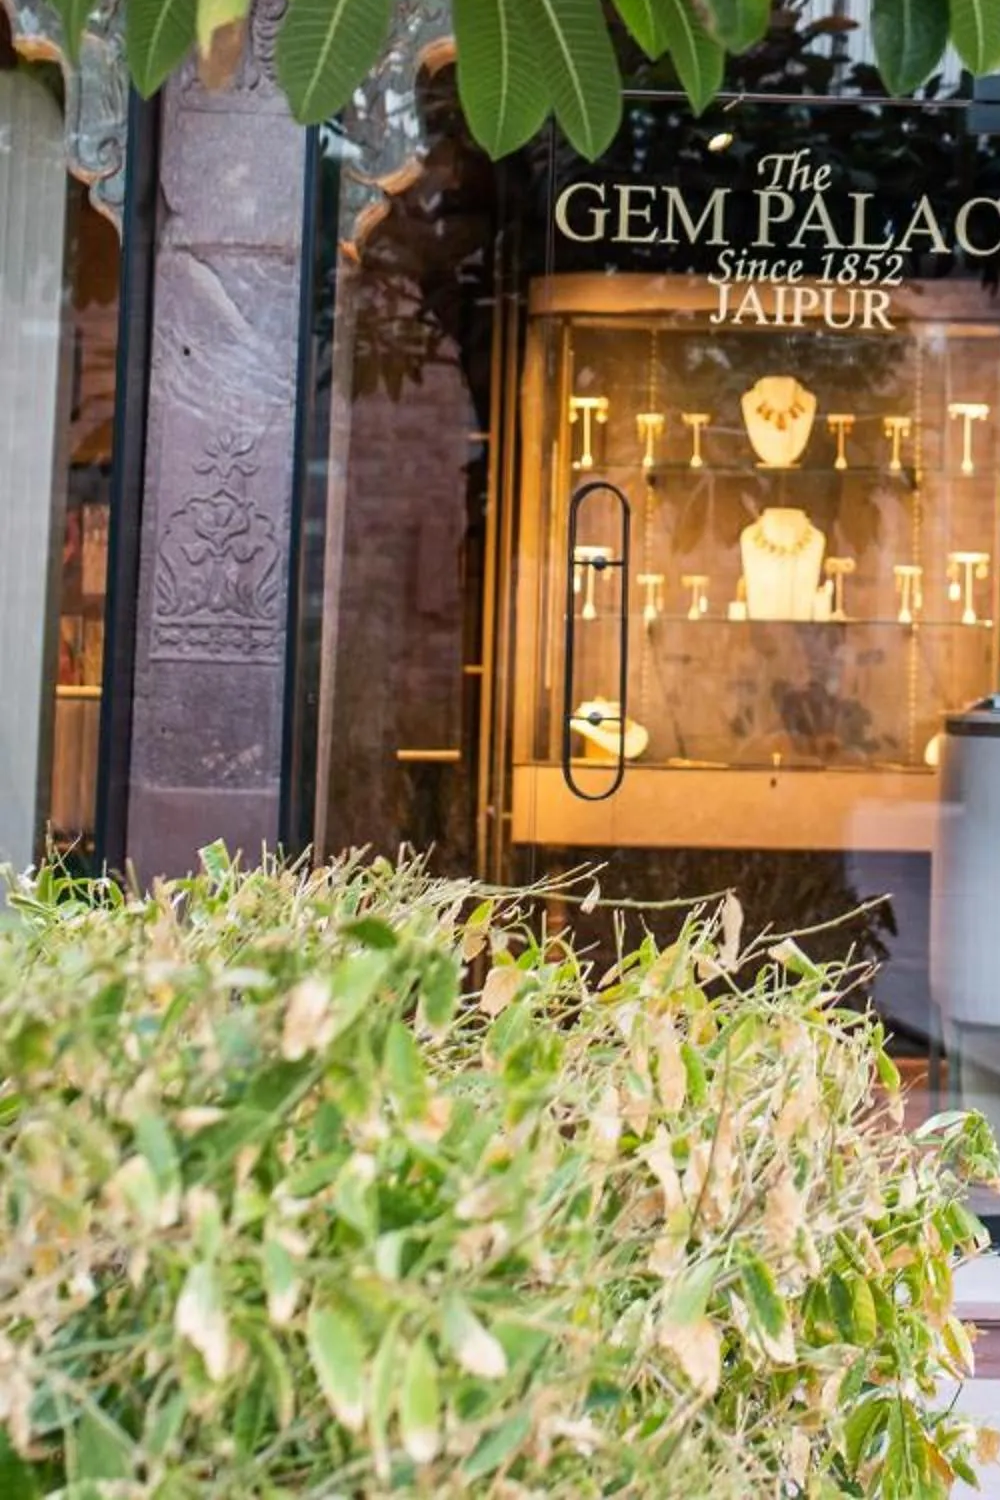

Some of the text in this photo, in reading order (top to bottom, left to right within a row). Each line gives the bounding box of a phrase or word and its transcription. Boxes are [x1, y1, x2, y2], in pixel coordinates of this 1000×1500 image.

[757, 148, 832, 193] The
[553, 182, 732, 247] GEM
[707, 248, 904, 287] Since 1852
[709, 283, 896, 330] JAIPUR
